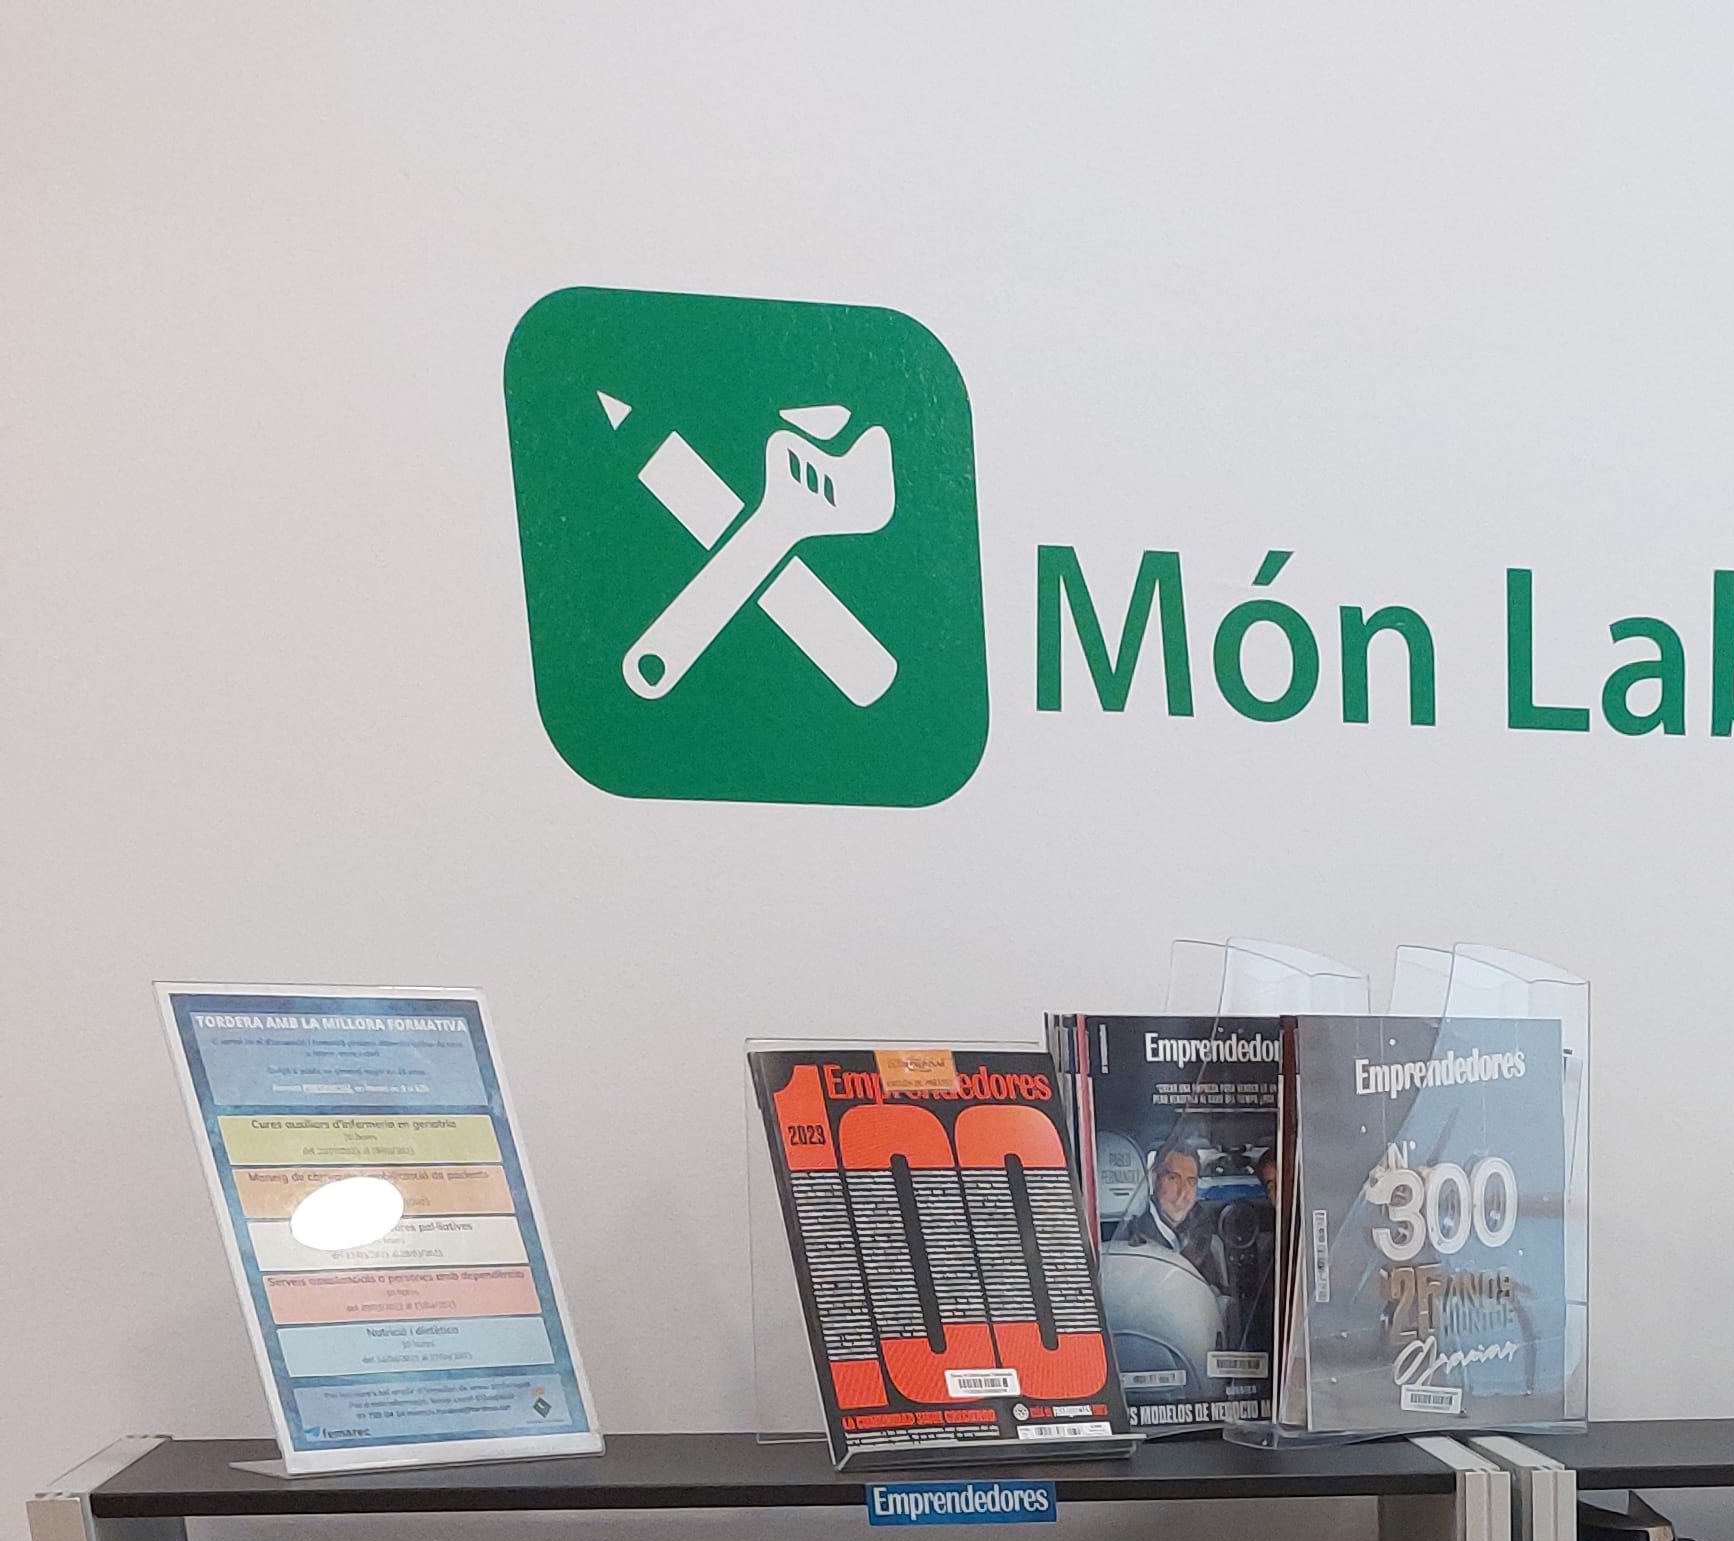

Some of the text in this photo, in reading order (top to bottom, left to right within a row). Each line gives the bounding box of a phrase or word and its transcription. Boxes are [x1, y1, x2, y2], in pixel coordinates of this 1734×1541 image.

[1033, 545, 1440, 729] Món
[302, 1017, 320, 1030] LA
[1355, 1048, 1526, 1099] Emprendedores
[787, 1124, 826, 1146] 2023
[1365, 1156, 1519, 1262] 300
[872, 1484, 1049, 1521] Emprendedores
